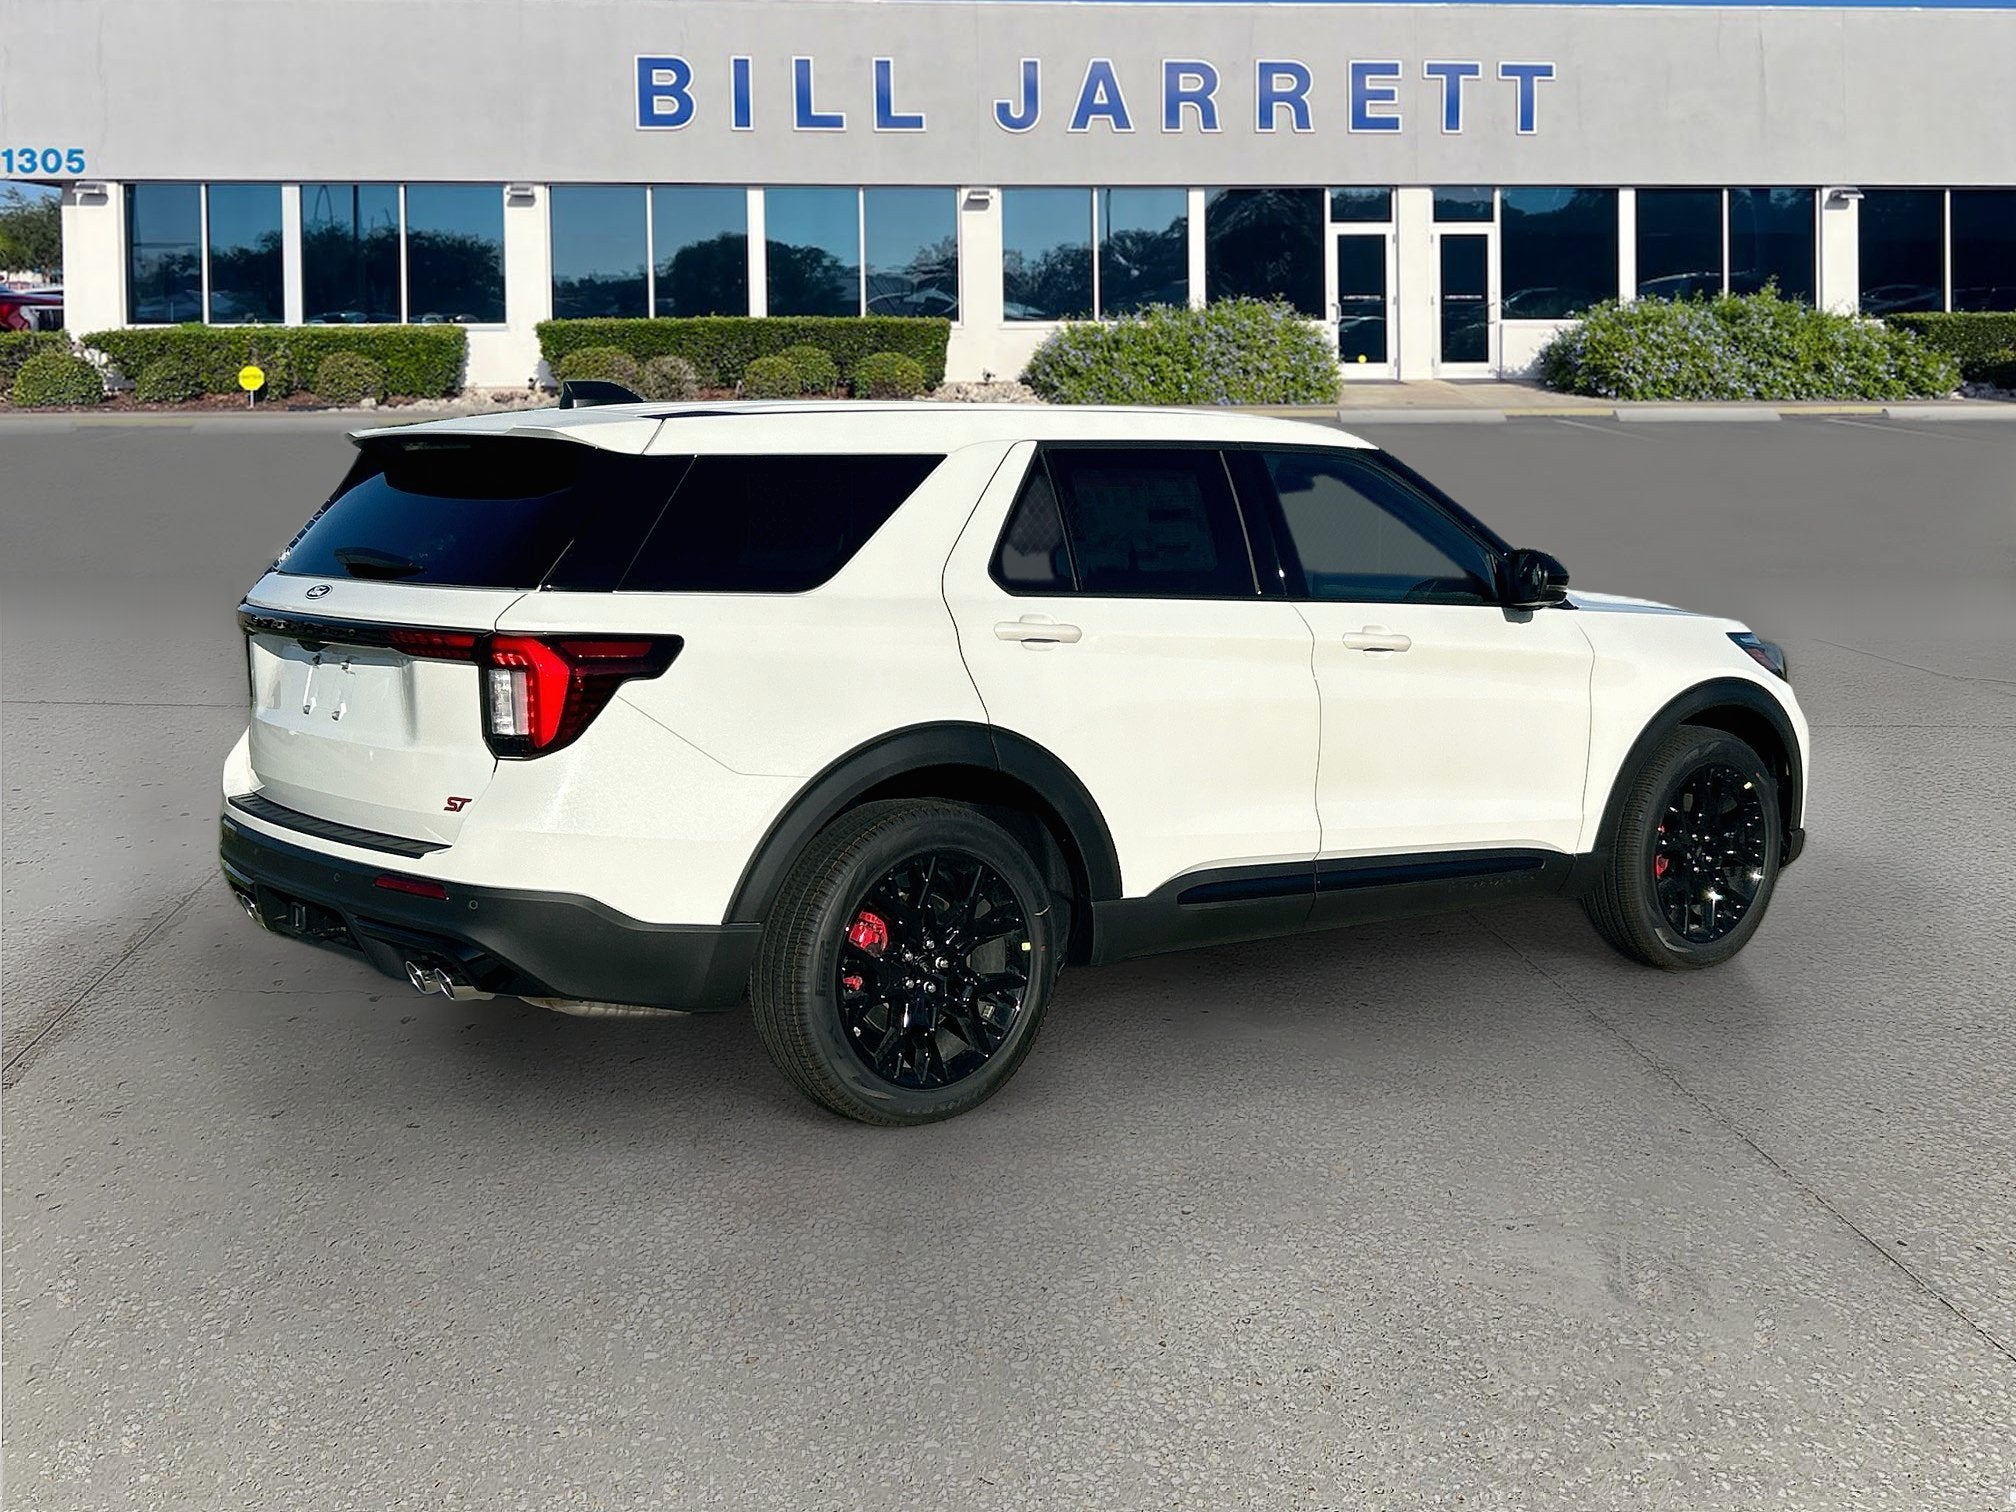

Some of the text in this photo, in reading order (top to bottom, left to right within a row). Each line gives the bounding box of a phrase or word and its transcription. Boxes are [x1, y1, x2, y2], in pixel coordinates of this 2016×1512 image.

[635, 54, 1556, 134] BILL JARRETT
[0, 148, 86, 174] 1305
[443, 796, 473, 812] ST
